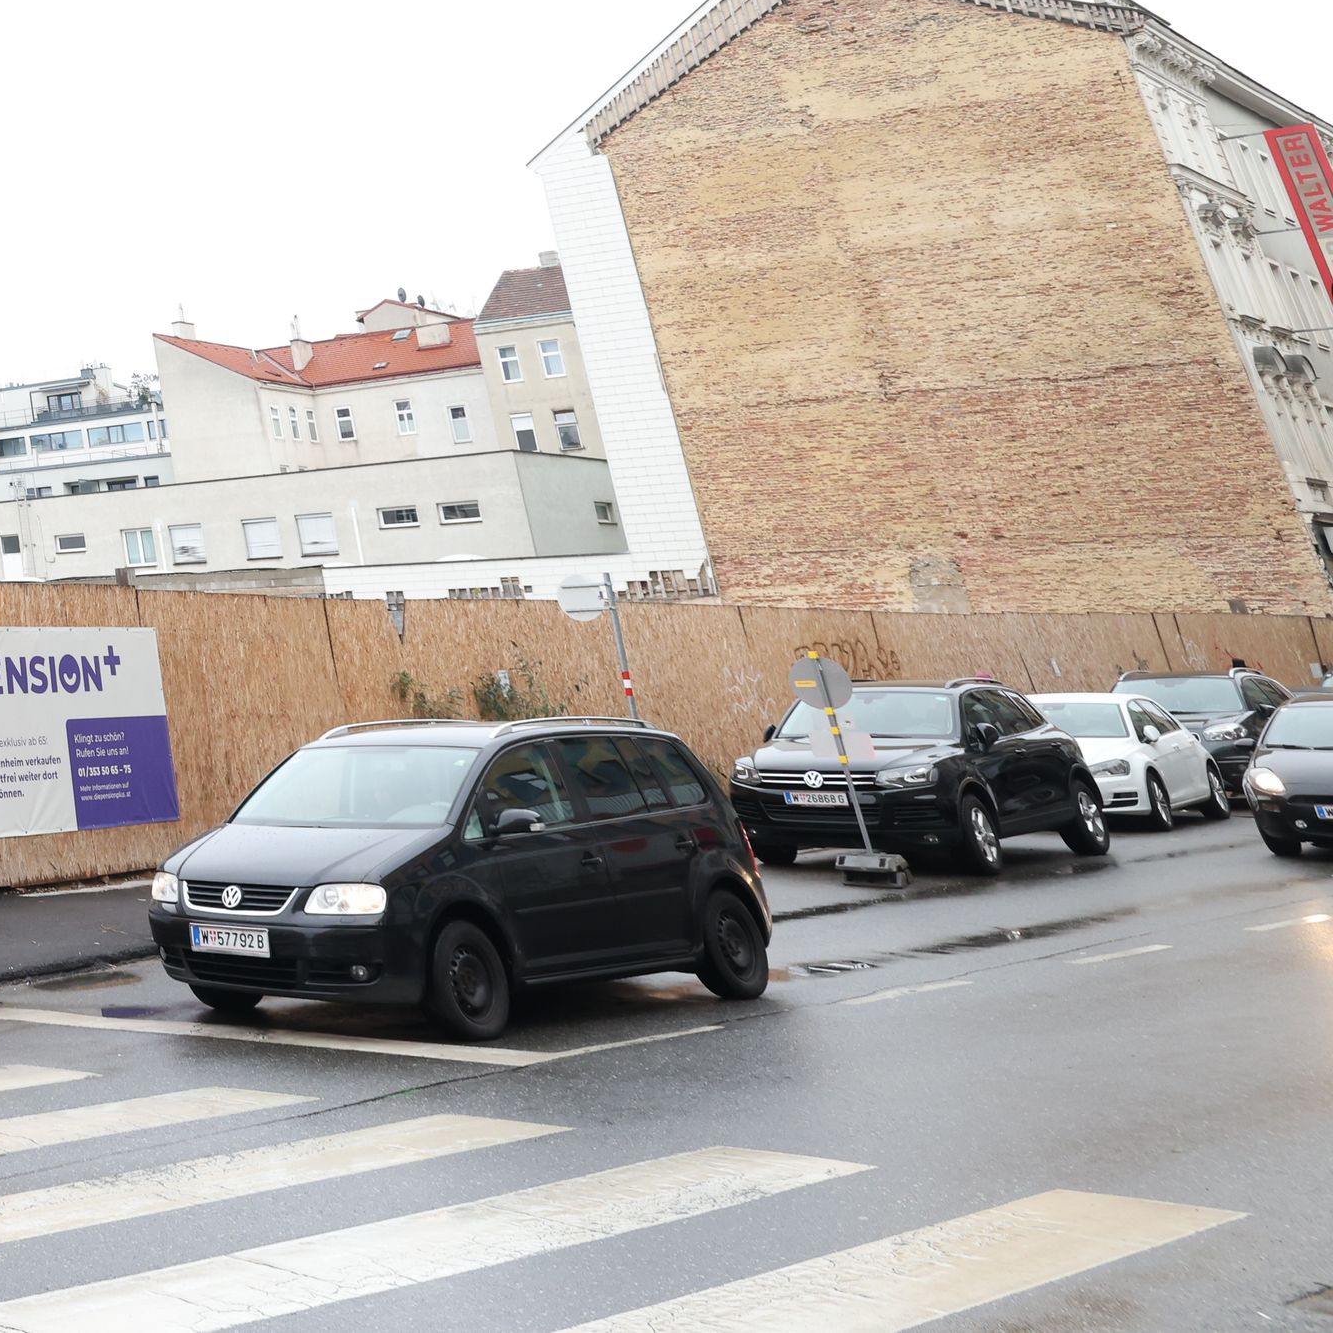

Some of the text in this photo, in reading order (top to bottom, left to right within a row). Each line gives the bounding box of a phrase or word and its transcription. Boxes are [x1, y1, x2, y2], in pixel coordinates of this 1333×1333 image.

[1284, 135, 1333, 233] WALTER
[28, 736, 37, 746] ab
[38, 735, 48, 746] 65:
[74, 731, 125, 745] Klingt zu schön?
[75, 746, 129, 758] Rufen Sie uns an!
[25, 755, 62, 767] verkaufen
[18, 771, 41, 782] weiter
[42, 770, 59, 780] dort
[77, 765, 101, 778] 01/353
[101, 766, 110, 776] 50
[110, 765, 119, 775] 65
[123, 764, 132, 774] 75
[79, 784, 91, 792] Mehr
[91, 782, 121, 792] Informationen
